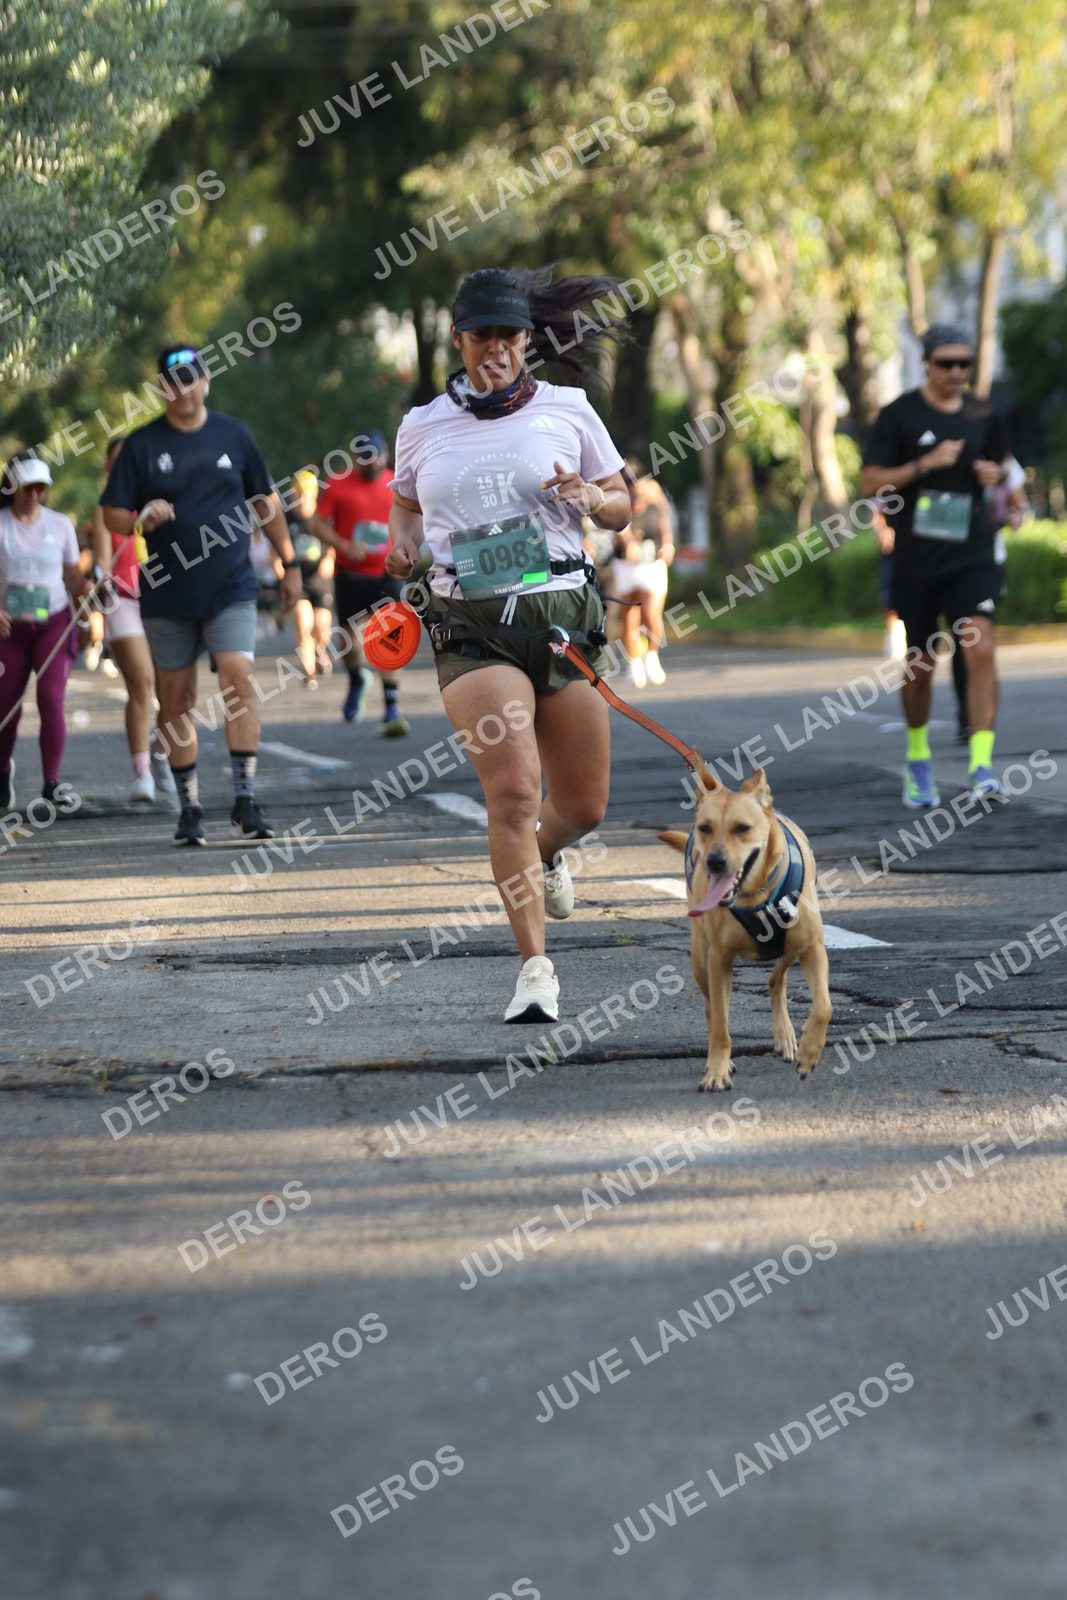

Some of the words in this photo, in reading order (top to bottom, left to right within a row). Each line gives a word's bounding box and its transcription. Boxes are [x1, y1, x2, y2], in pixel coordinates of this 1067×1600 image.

[477, 475, 493, 490] 15
[497, 471, 522, 504] K
[481, 493, 497, 508] 30
[479, 540, 545, 576] 0983
